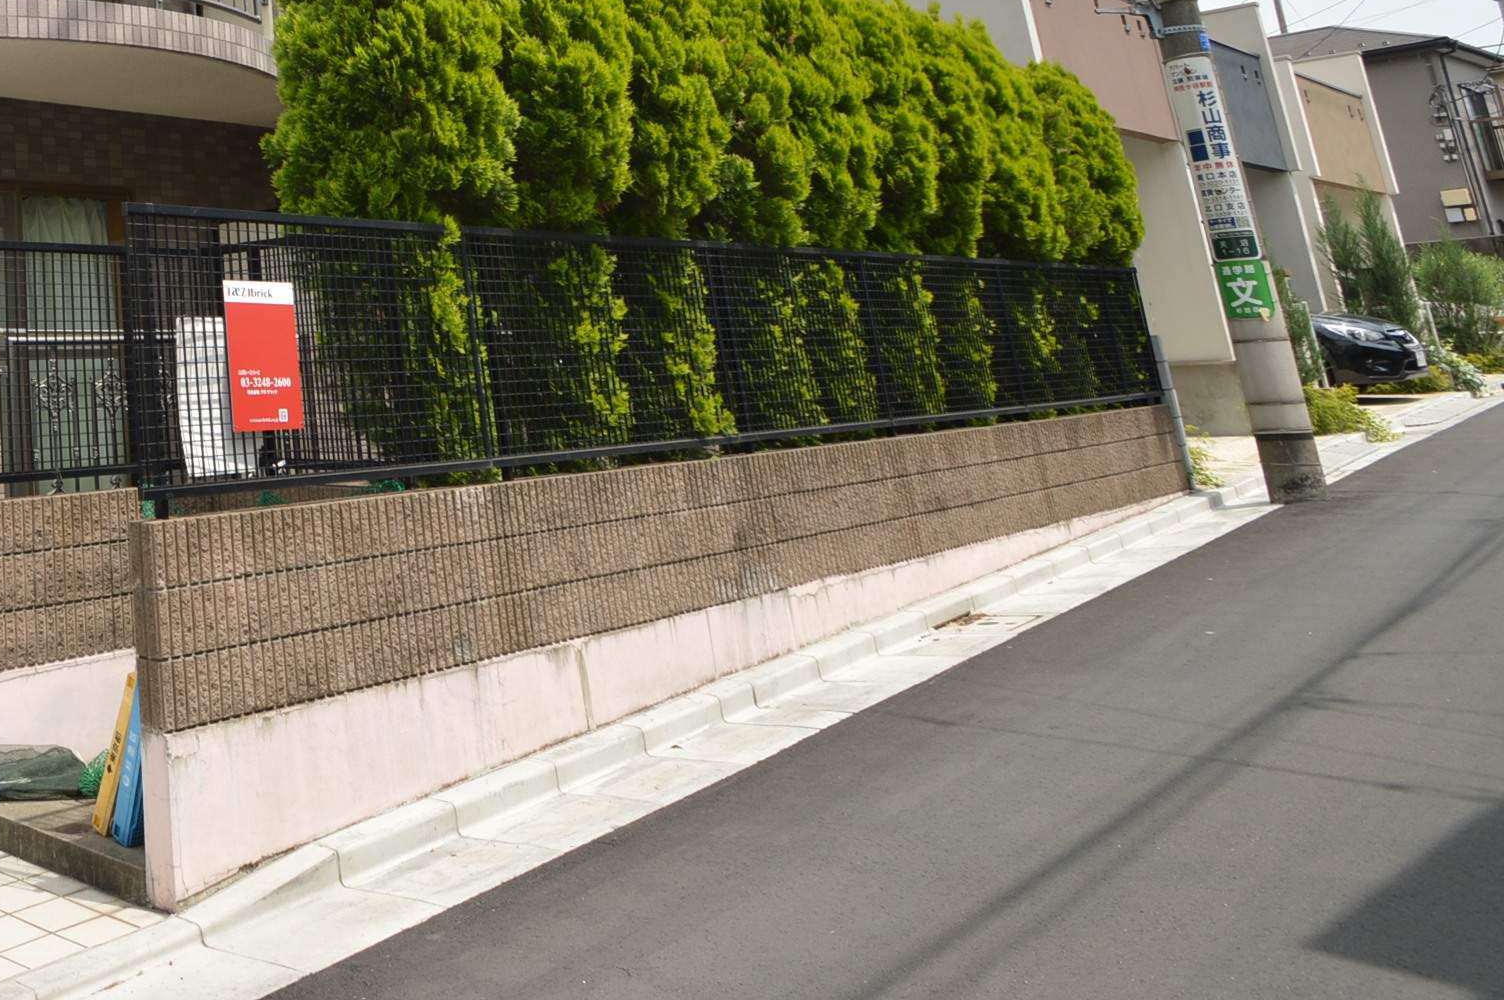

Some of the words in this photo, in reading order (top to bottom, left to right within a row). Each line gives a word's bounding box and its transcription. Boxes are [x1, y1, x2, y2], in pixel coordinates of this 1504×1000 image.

[1197, 90, 1232, 160] 杉山商事
[1226, 277, 1264, 308] 文
